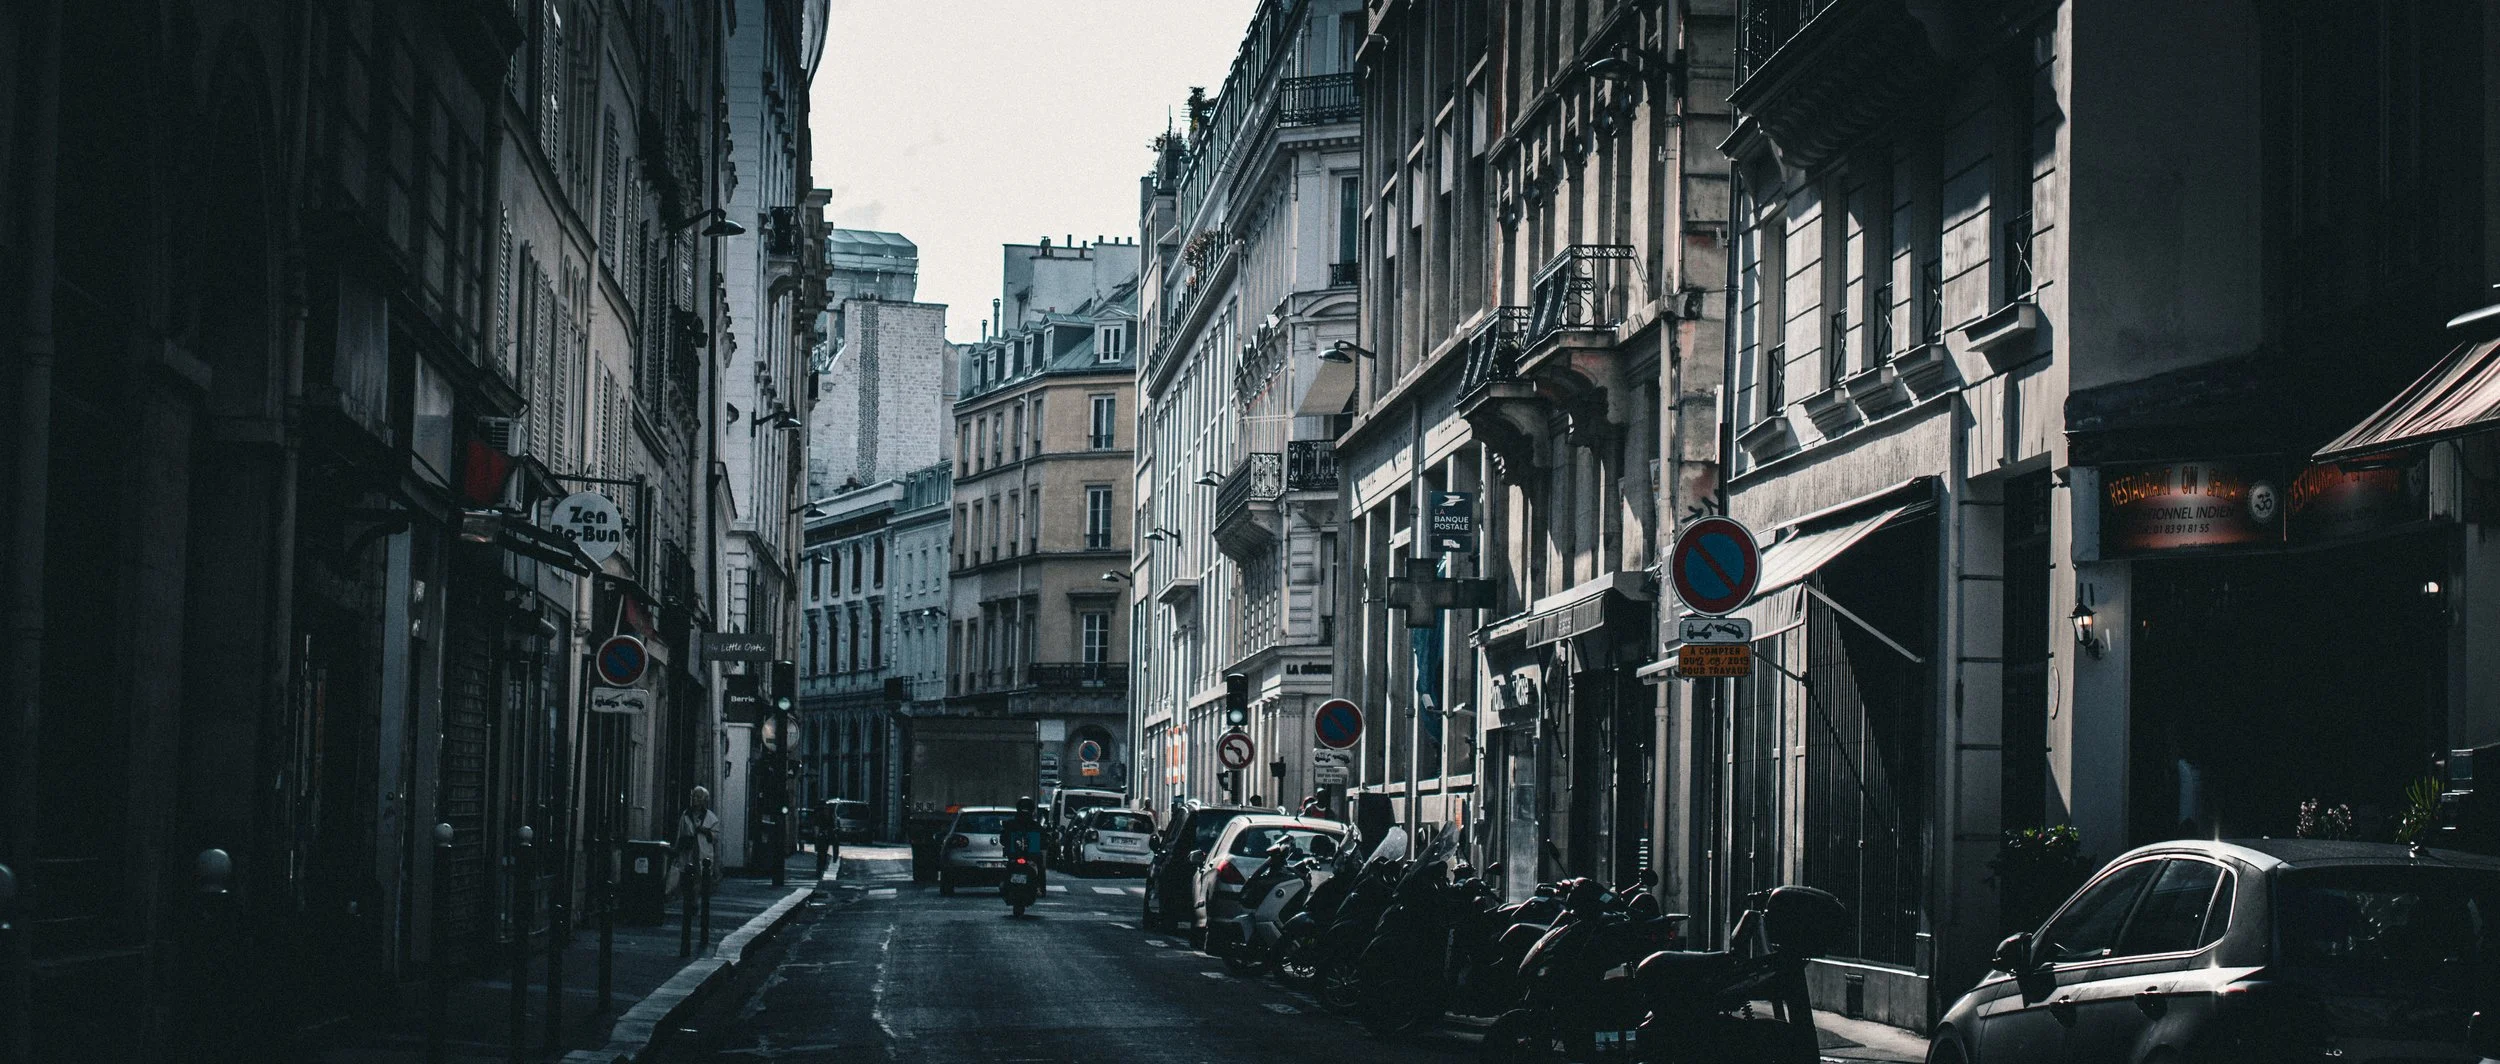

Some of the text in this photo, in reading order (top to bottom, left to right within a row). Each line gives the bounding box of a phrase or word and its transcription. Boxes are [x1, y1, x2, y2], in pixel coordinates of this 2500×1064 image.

[2108, 466, 2172, 507] RESTAURANT
[2181, 466, 2199, 494] OM
[570, 506, 608, 524] Zen
[2195, 506, 2234, 519] INDIEN
[1434, 516, 1469, 524] BANQUE
[1434, 523, 1469, 531] POSTALE
[2153, 525, 2163, 534] 01
[2164, 524, 2175, 534] 83
[2176, 524, 2186, 534] 91
[2187, 524, 2197, 533] 81
[2199, 523, 2210, 532] 55
[720, 642, 742, 653] Little
[744, 642, 767, 653] Optic
[1699, 647, 1740, 655] COMPTER
[1681, 666, 1749, 675] POUR TRAVAUX
